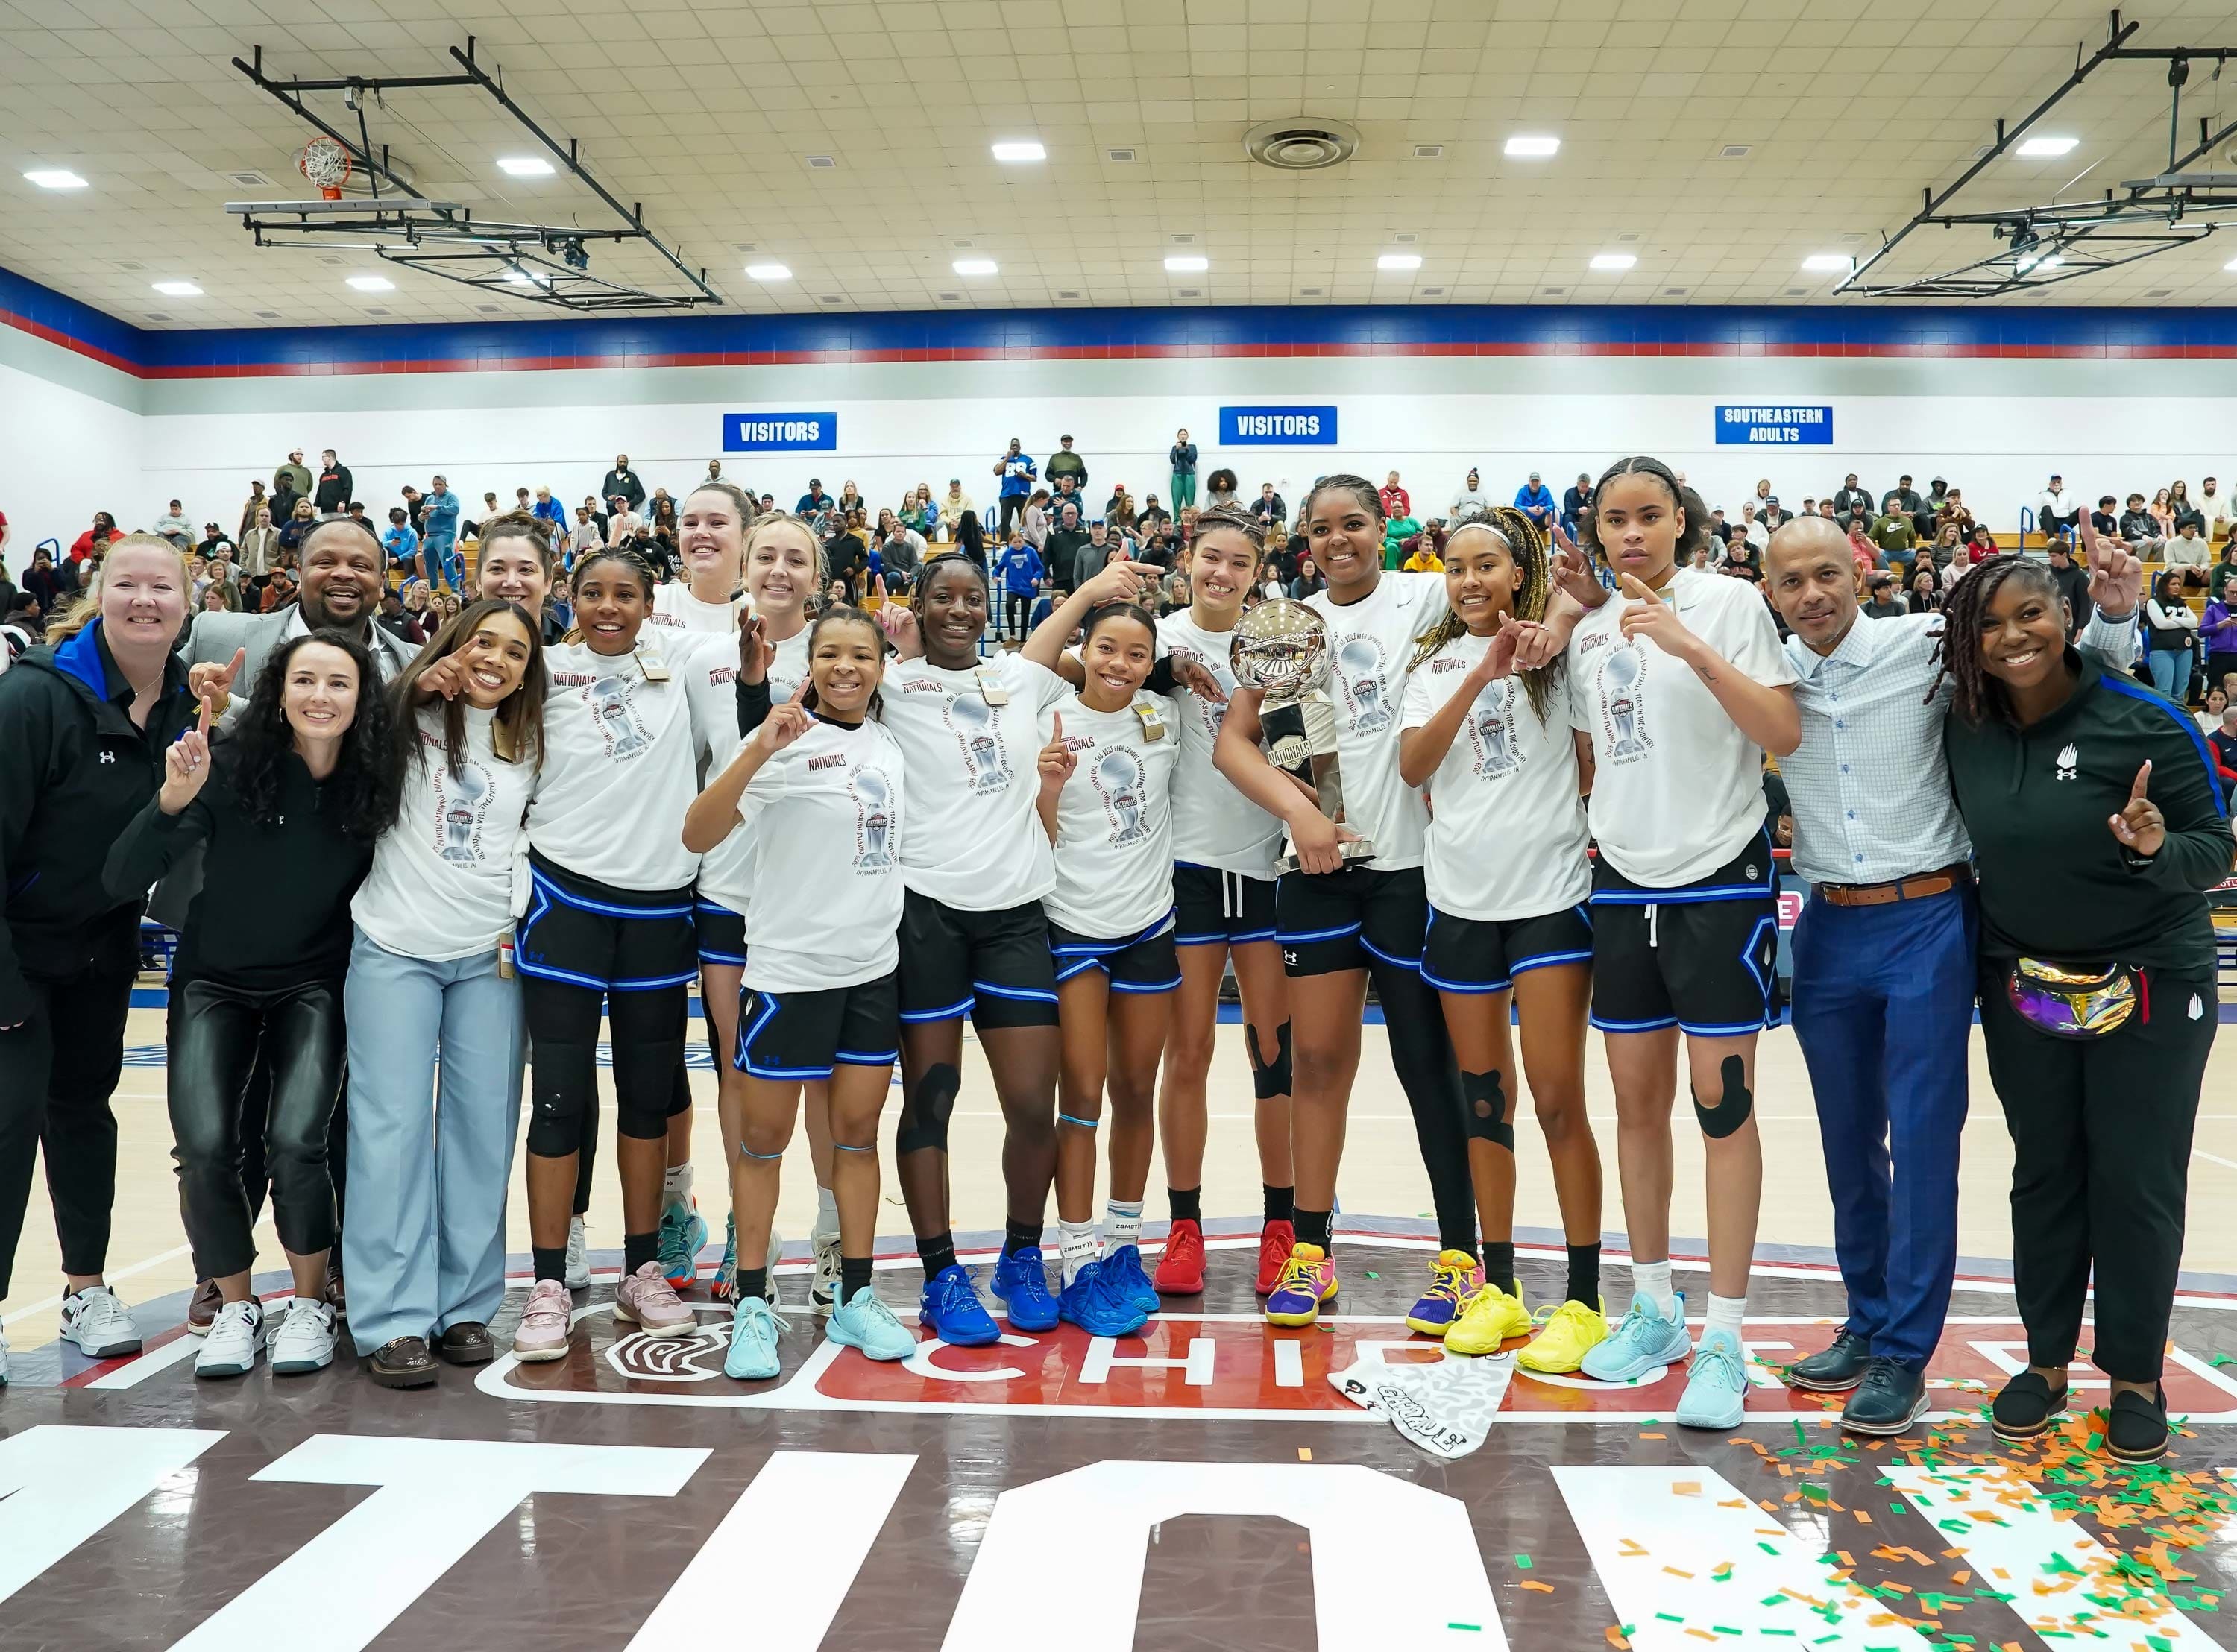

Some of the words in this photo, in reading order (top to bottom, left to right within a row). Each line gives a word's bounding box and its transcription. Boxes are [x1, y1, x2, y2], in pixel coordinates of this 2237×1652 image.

[1724, 408, 1824, 424] SOUTHEASTERN
[740, 422, 819, 442] VISITORS
[1237, 415, 1320, 435] VISITORS
[1749, 427, 1800, 443] ADULTS
[648, 614, 686, 629] NATIONALS
[1580, 632, 1609, 655] NATIONALS
[1614, 641, 1624, 654] BEST
[1432, 659, 1467, 675] NATIONALS
[553, 672, 597, 687] NATIONALS
[710, 670, 735, 687] NATION
[904, 682, 943, 694] NATIONALS
[1635, 693, 1643, 708] TEAM
[1348, 719, 1356, 731] 2025
[1505, 712, 1514, 727] TEAM
[1637, 716, 1646, 726] THE
[1480, 722, 1505, 736] NATIONALS
[1637, 725, 1655, 748] COUNTRY
[1064, 737, 1095, 752] TIONALS
[1508, 734, 1518, 744] THE
[1268, 742, 1311, 767] NATIONALS
[1509, 743, 1527, 764] COUNTRY
[1605, 744, 1614, 758] 2025
[808, 754, 846, 772] NATIONALS
[1001, 759, 1015, 780] COUNTRY
[1473, 762, 1482, 775] 2025
